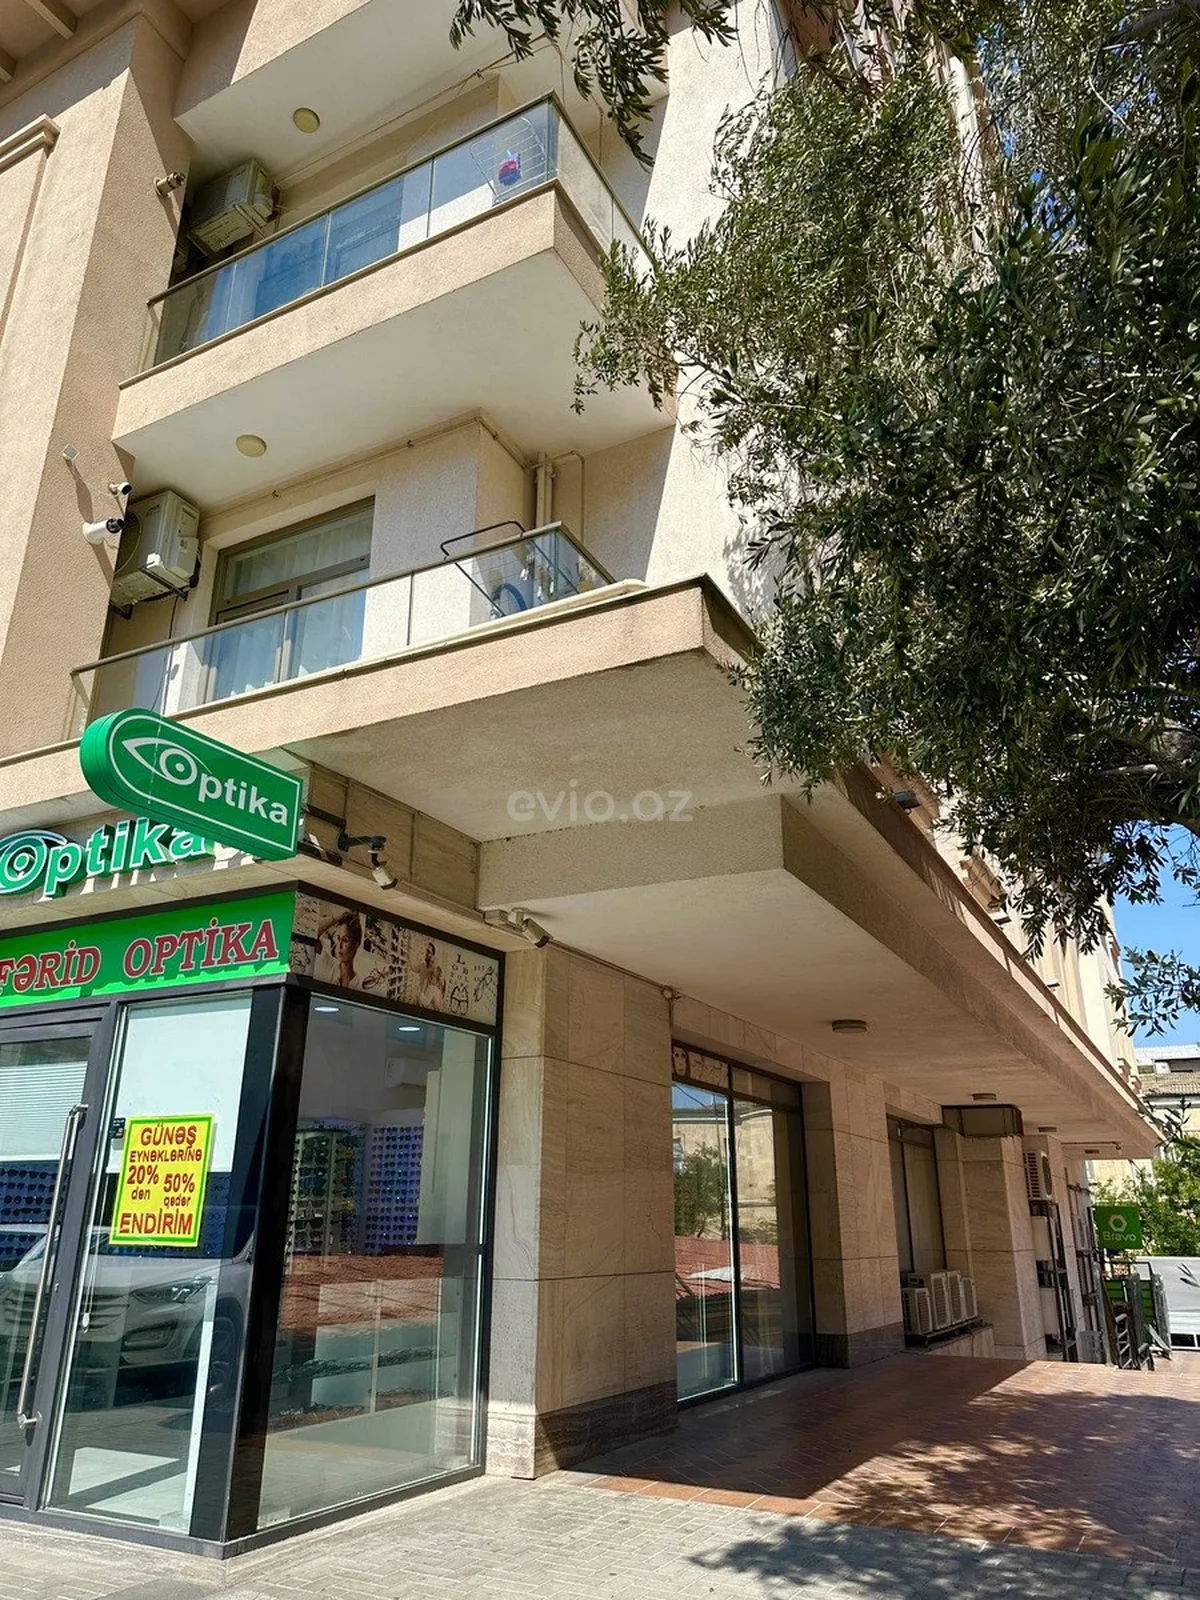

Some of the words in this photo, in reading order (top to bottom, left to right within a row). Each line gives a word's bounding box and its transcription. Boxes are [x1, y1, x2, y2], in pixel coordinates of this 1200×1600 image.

[158, 747, 289, 827] Optika
[0, 816, 207, 896] Optika
[123, 917, 279, 978] OPTİKA
[140, 1122, 198, 1149] GÜNƏŞ
[126, 1164, 160, 1185] 20%
[163, 1173, 196, 1194] 50%
[119, 1208, 194, 1235] ENDİRİM
[1102, 1230, 1137, 1242] Bravo
